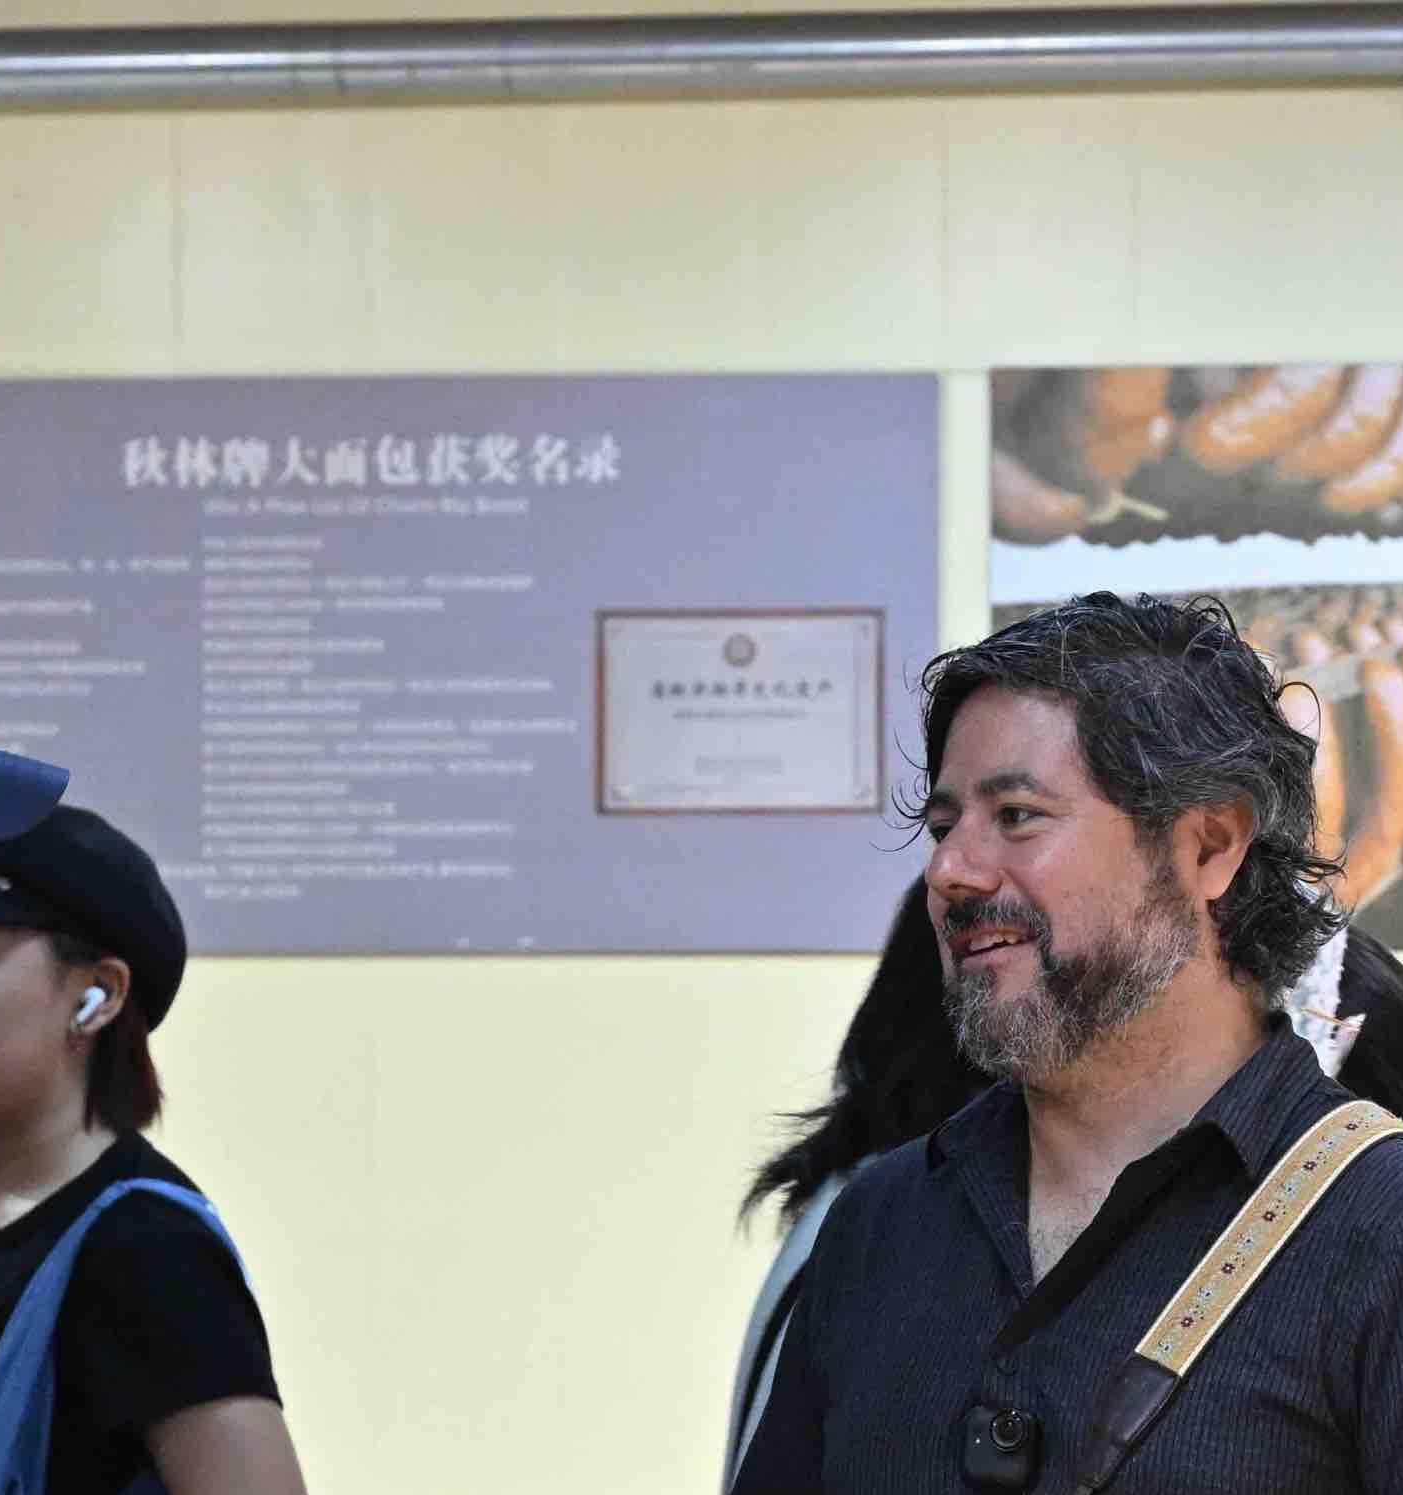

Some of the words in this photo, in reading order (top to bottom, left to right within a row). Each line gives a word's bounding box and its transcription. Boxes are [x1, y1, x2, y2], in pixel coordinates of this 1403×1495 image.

[122, 434, 622, 488] 秋林牌大面包获奖名录
